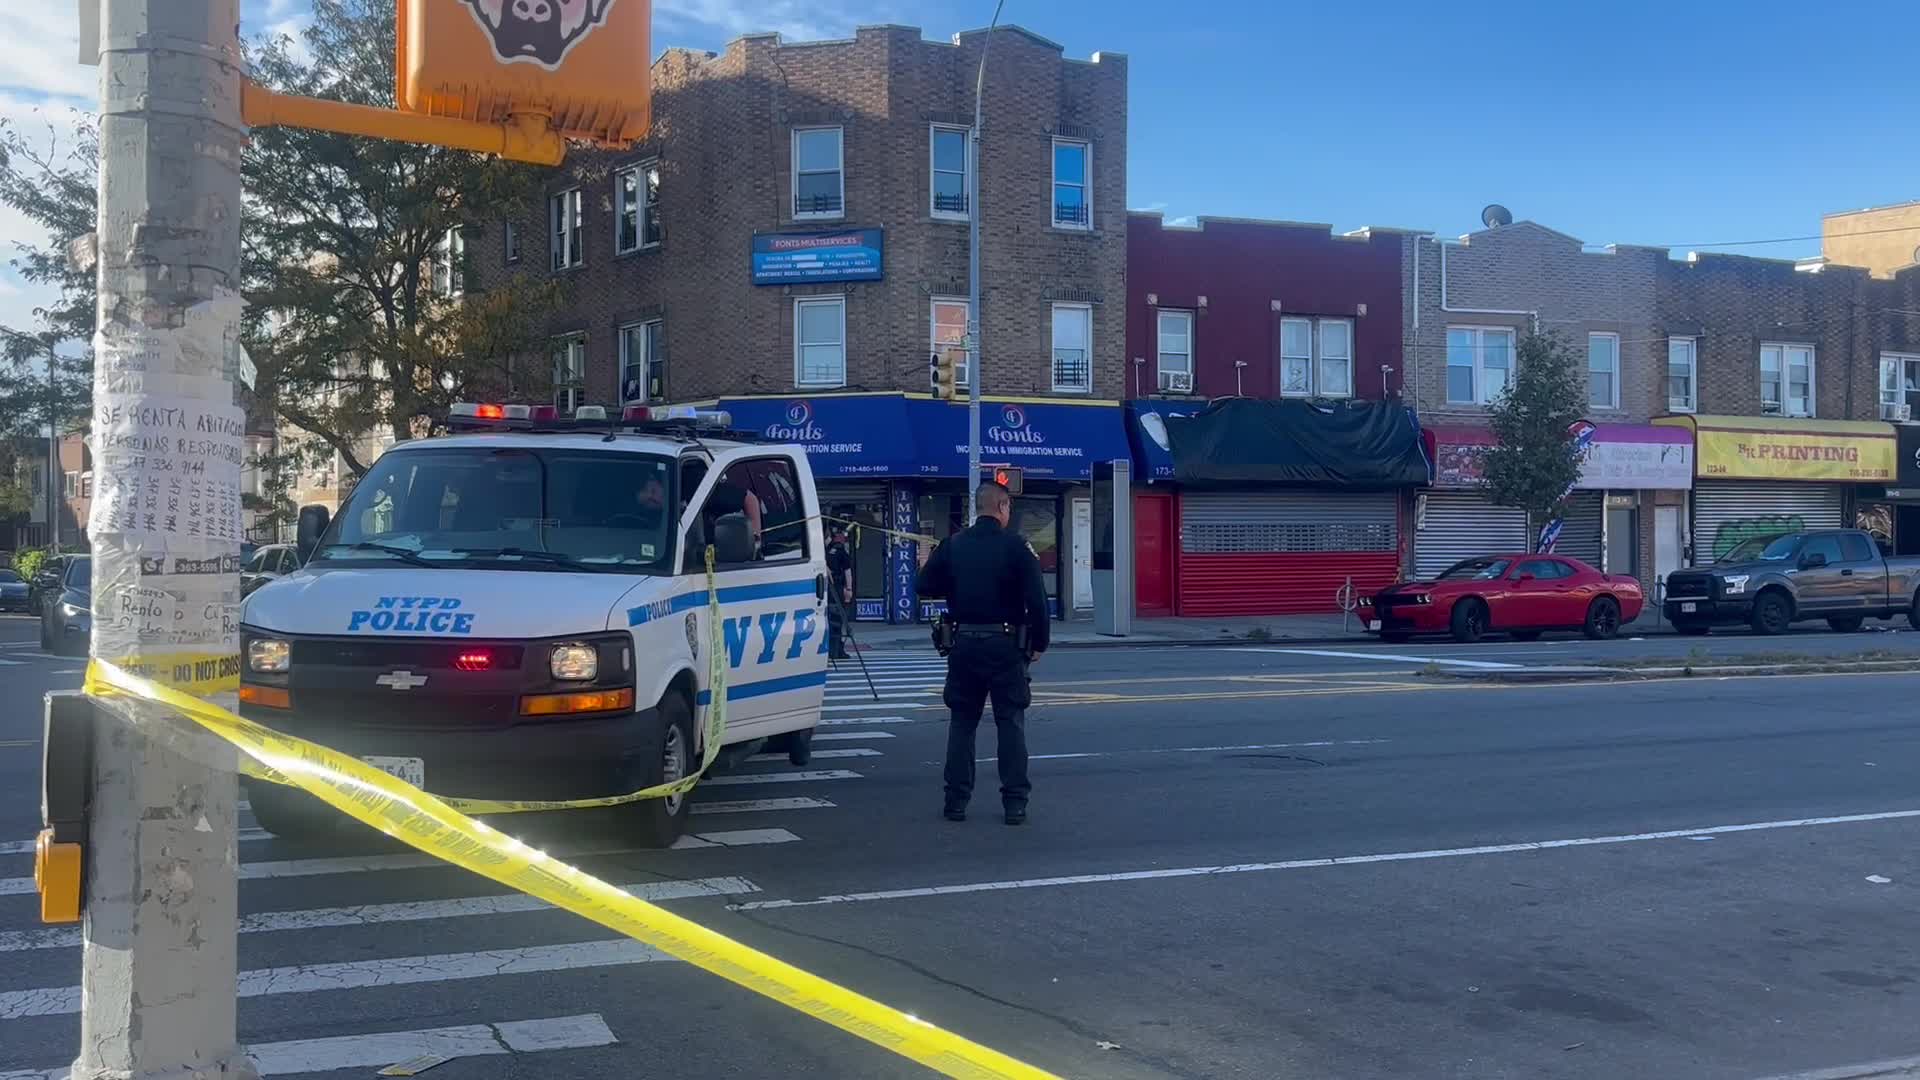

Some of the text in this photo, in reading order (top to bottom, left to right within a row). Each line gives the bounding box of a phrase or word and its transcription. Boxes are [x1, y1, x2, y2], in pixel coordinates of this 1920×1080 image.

[775, 239, 799, 248] FONTS
[101, 405, 121, 425] SE
[830, 443, 862, 453] SERVICE
[985, 446, 1000, 455] TAX
[1008, 446, 1053, 456] IMMIGRATION
[1054, 447, 1084, 457] SERVICE
[1758, 444, 1858, 463] PRINTING
[374, 596, 462, 610] NYPD
[647, 598, 672, 621] POLICE
[857, 603, 883, 616] REALTY
[347, 610, 475, 634] POLICE
[722, 608, 828, 669] NYP
[195, 660, 217, 681] NOT
